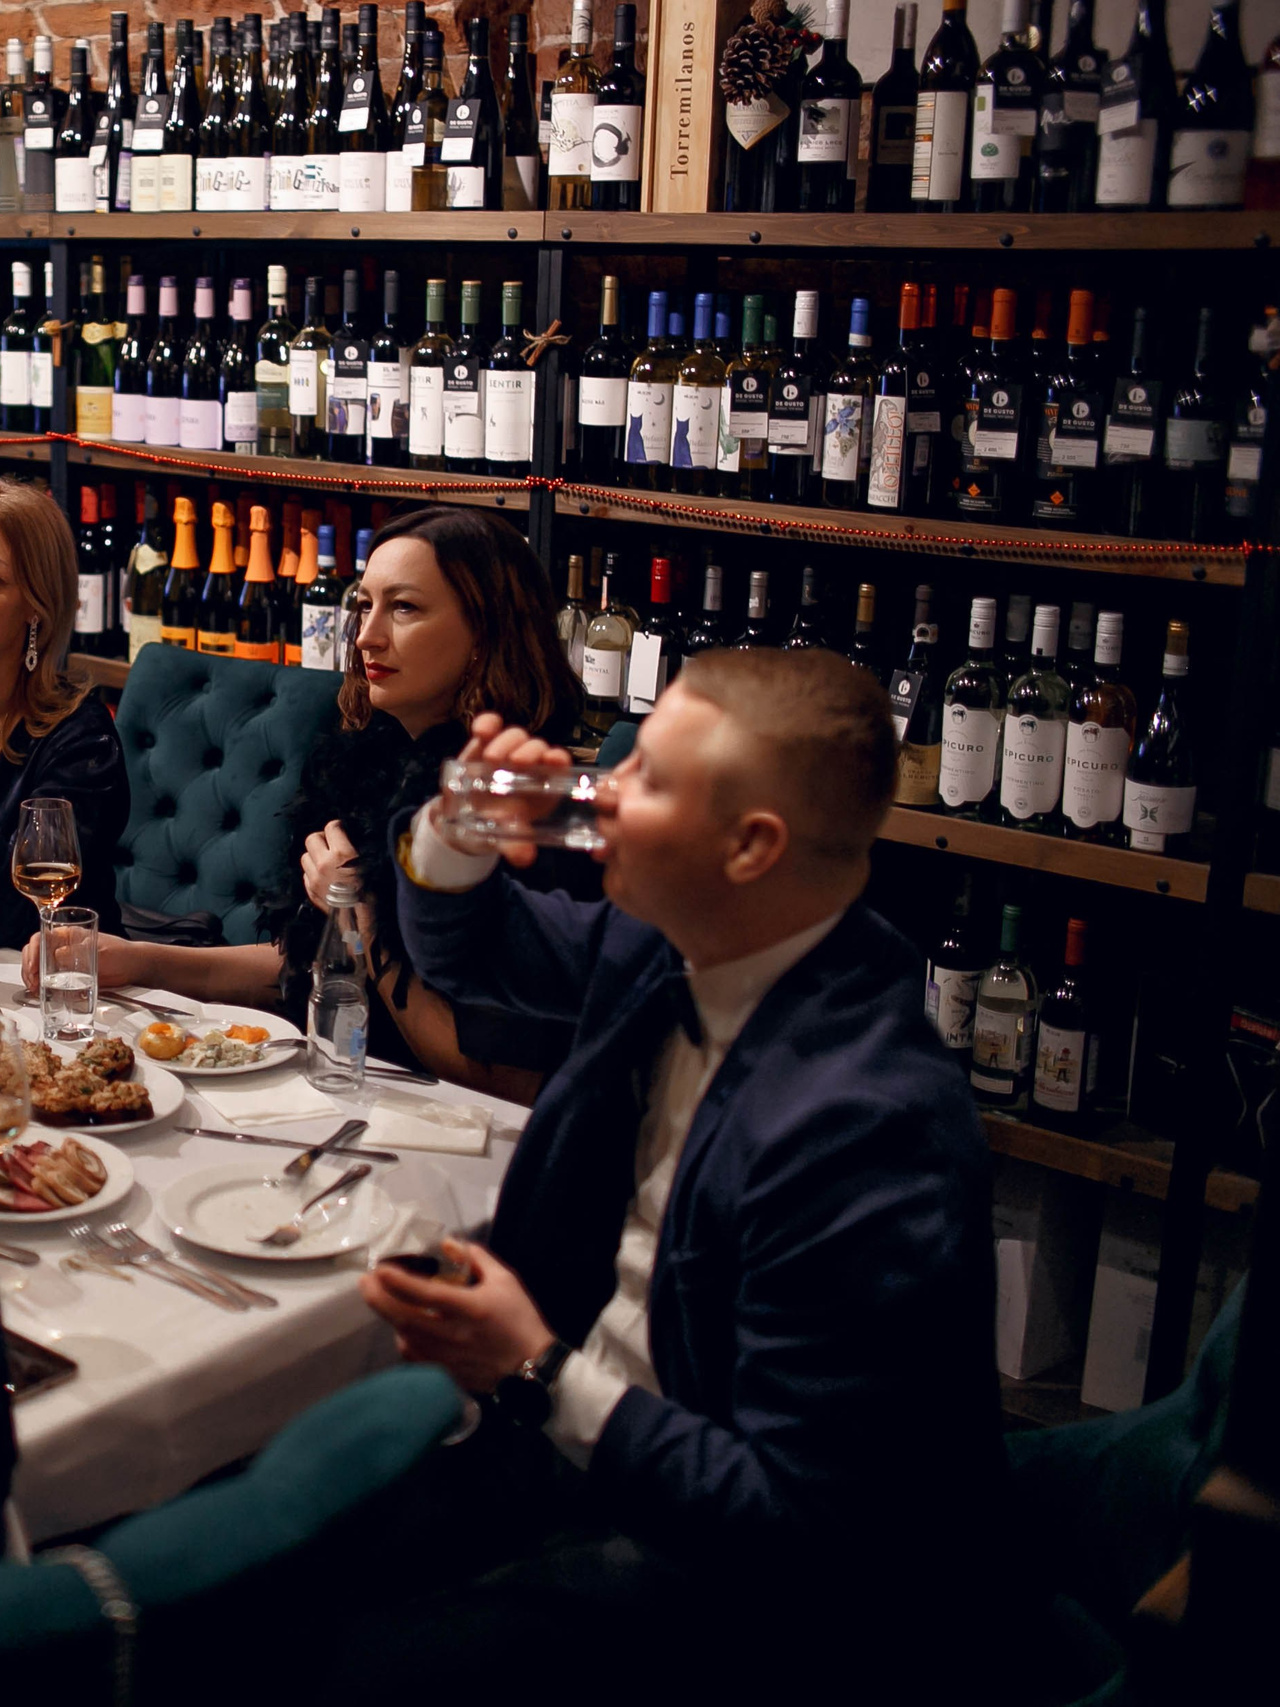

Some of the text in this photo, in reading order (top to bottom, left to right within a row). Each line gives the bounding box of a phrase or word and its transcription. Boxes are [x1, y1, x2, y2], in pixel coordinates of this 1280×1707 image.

[670, 21, 695, 180] Torremilanos
[489, 379, 522, 388] SENTIR
[1128, 404, 1152, 412] GUSTO
[1072, 419, 1096, 427] GUSTO
[1005, 748, 1054, 763] EPICURO
[1067, 756, 1119, 771] EPICURO
